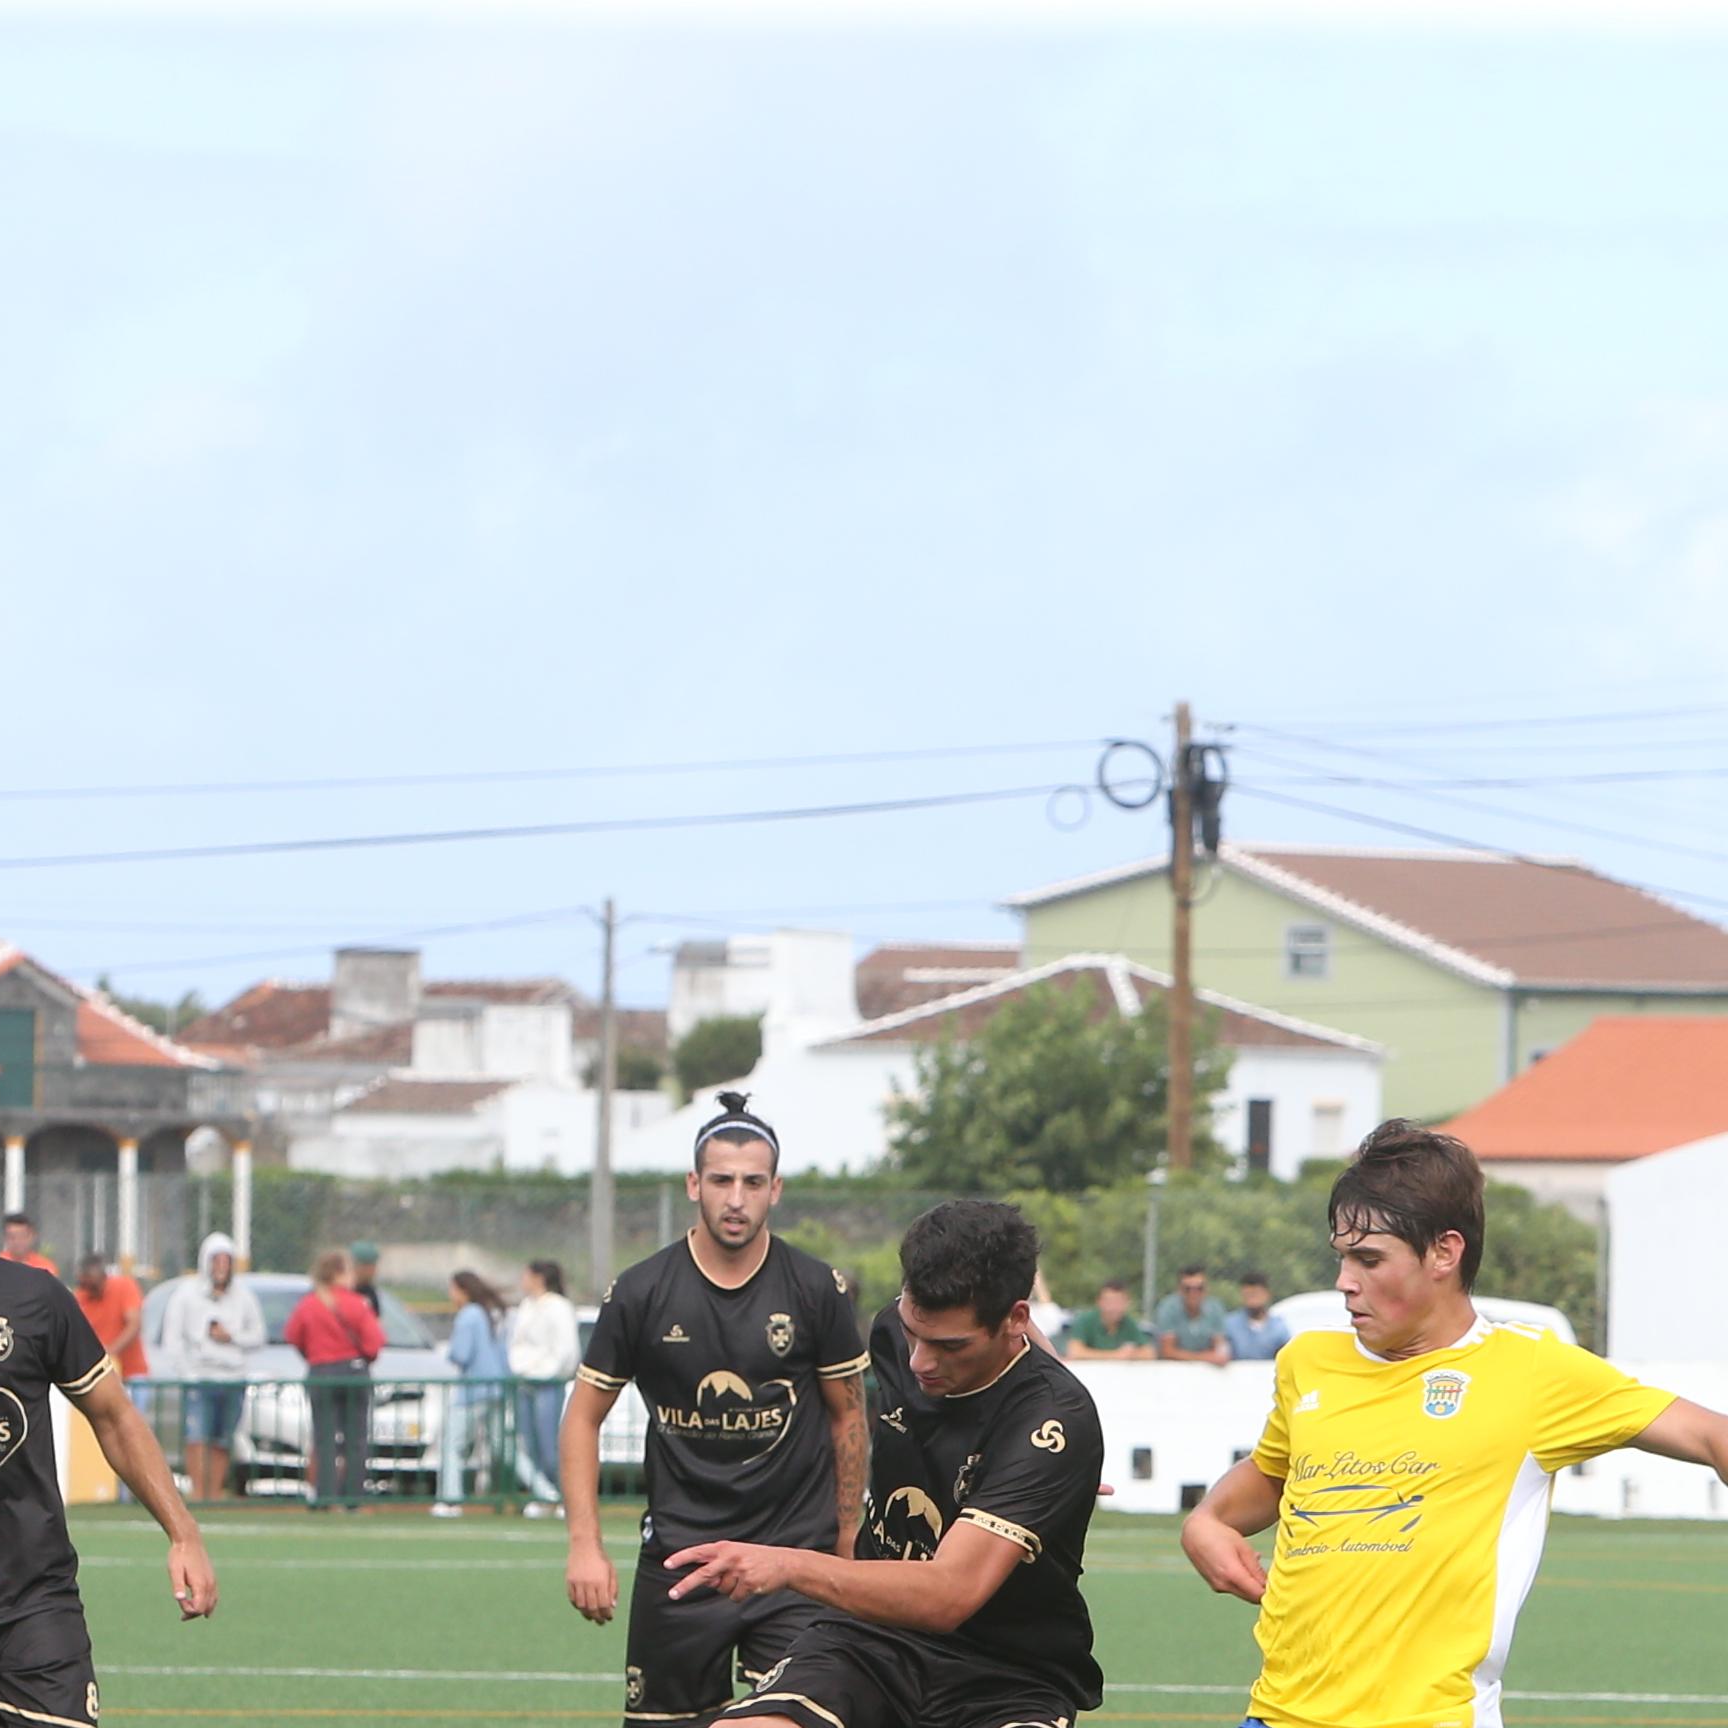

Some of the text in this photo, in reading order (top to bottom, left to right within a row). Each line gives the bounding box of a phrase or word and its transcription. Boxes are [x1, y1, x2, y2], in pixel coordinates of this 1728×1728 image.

[656, 1405, 784, 1431] VILA DAS LAJES
[1323, 1450, 1392, 1480] Litos
[1390, 1450, 1441, 1476] Car
[1331, 1537, 1415, 1553] Automóvel
